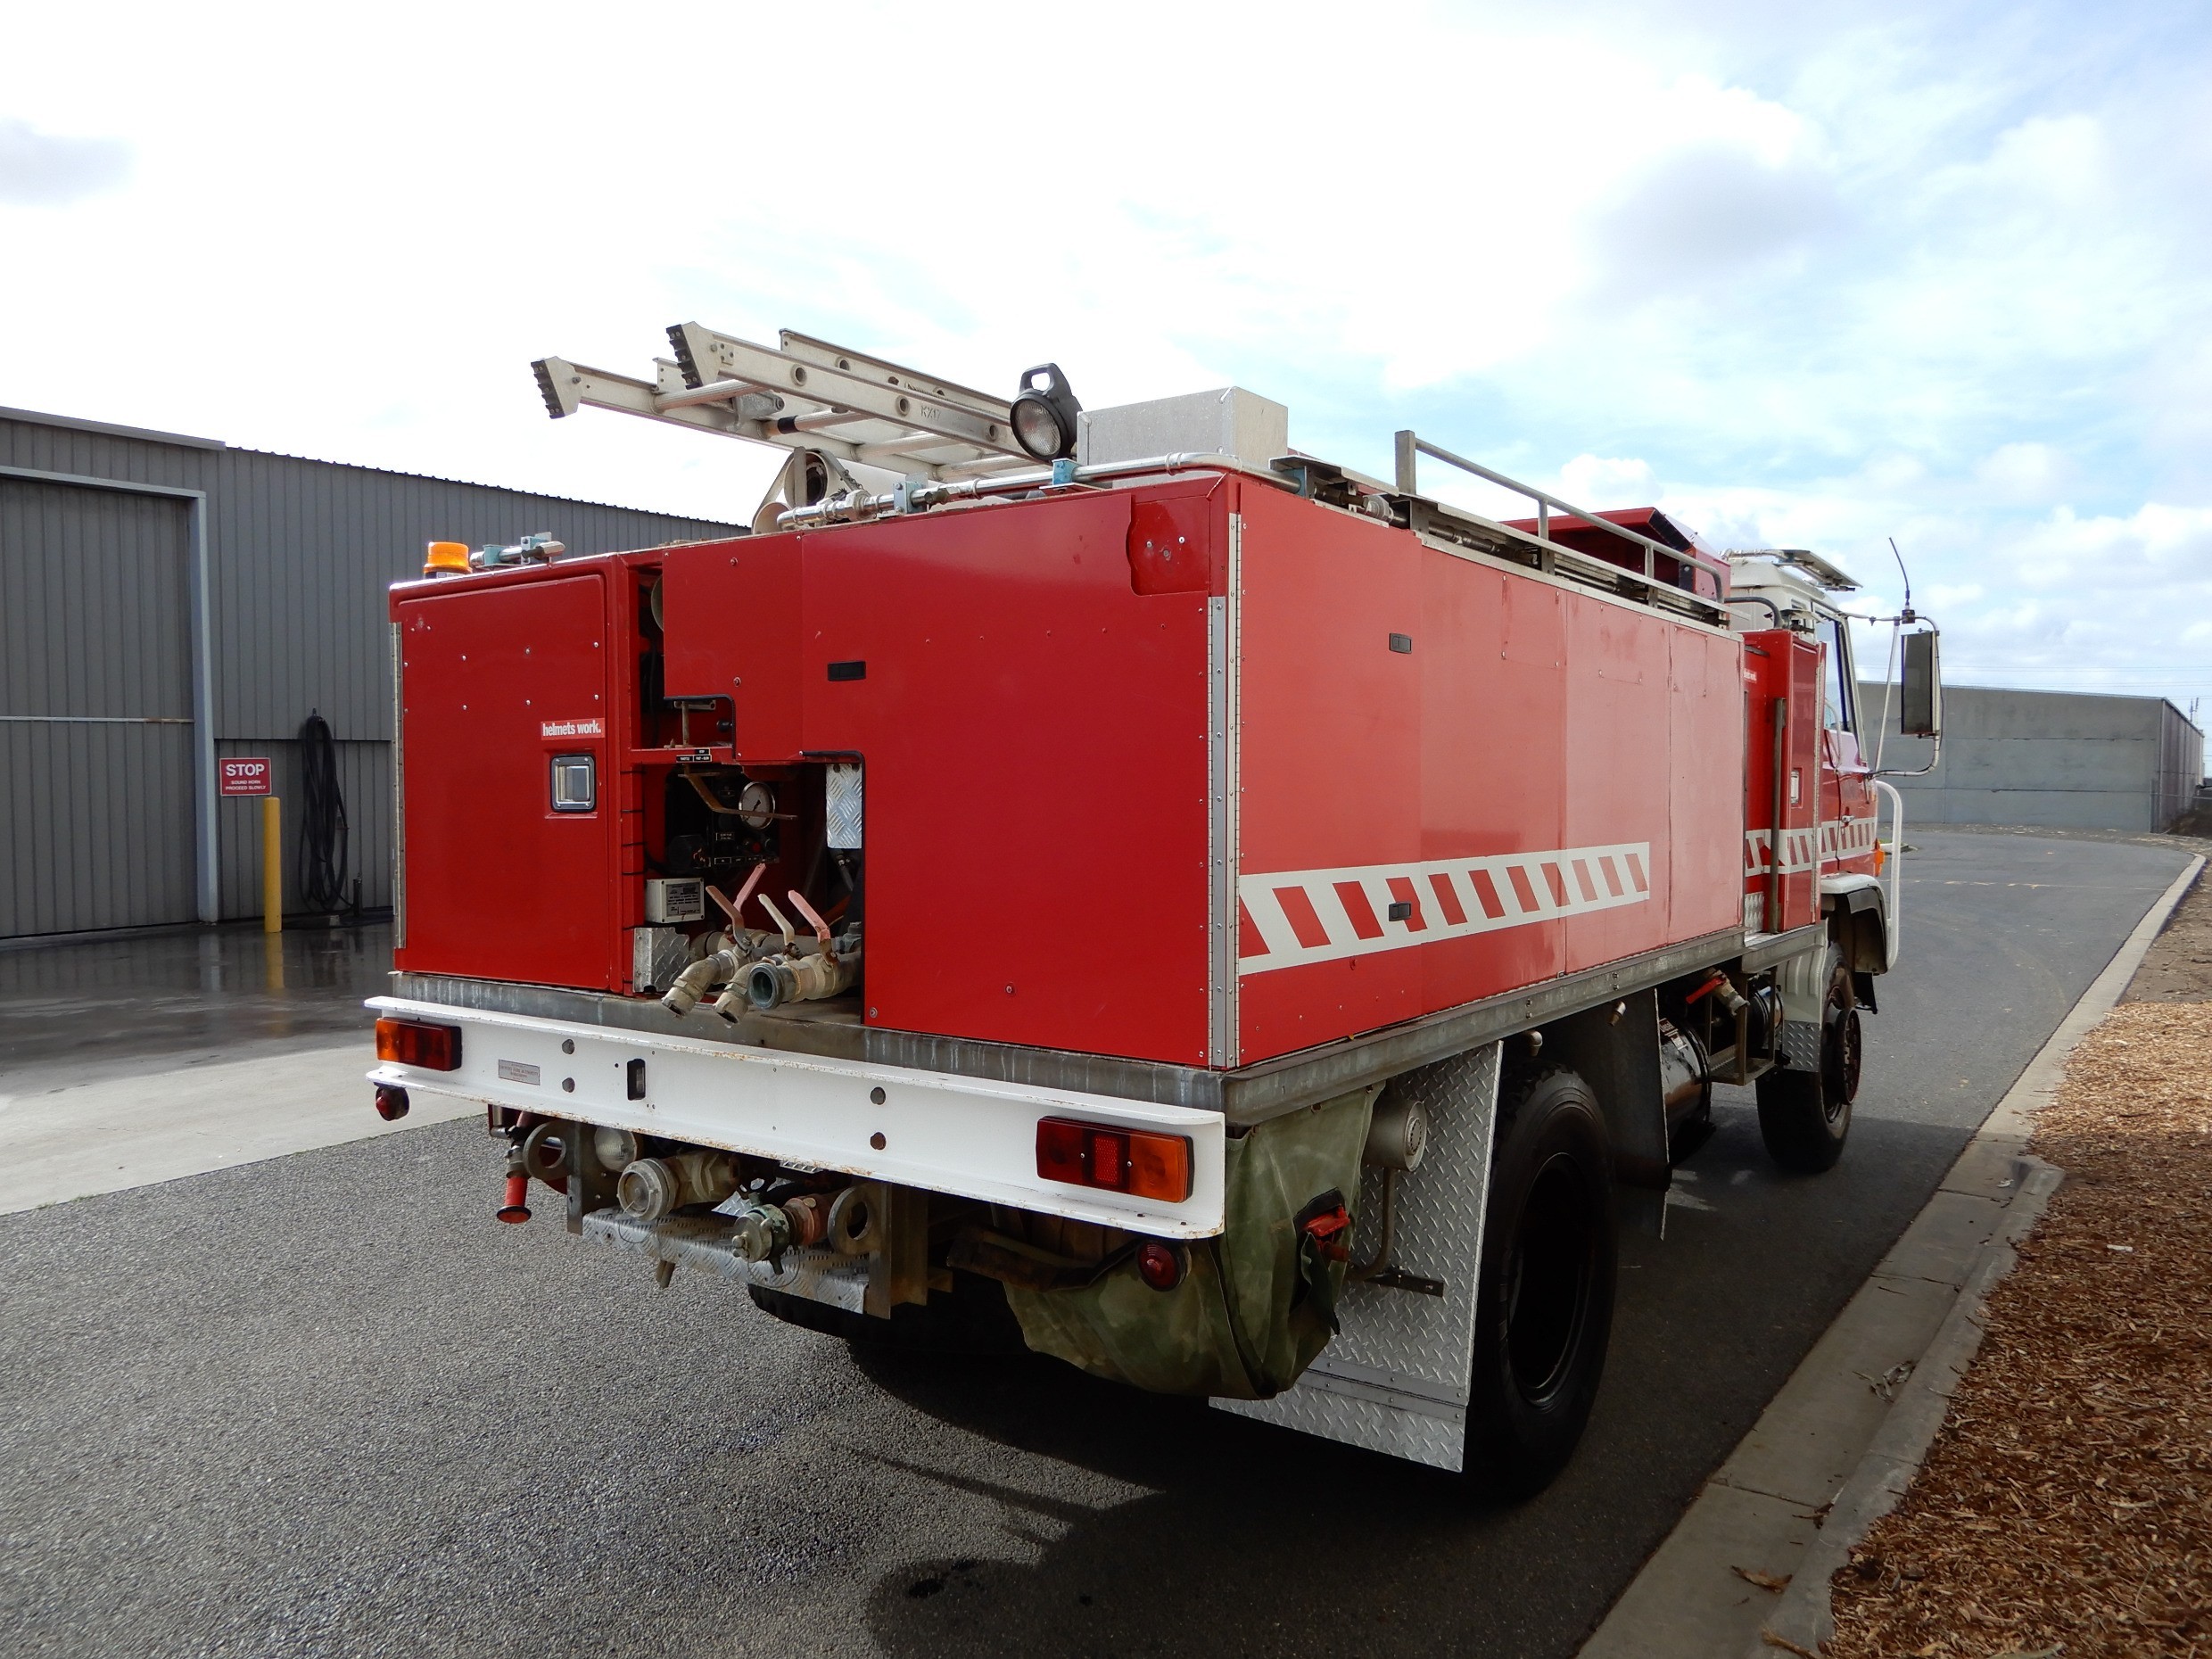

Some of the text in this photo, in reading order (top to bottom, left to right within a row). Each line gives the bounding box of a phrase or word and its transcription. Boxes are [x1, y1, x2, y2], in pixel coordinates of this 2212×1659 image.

[542, 719, 602, 737] helmets work.
[226, 763, 265, 776] STOP
